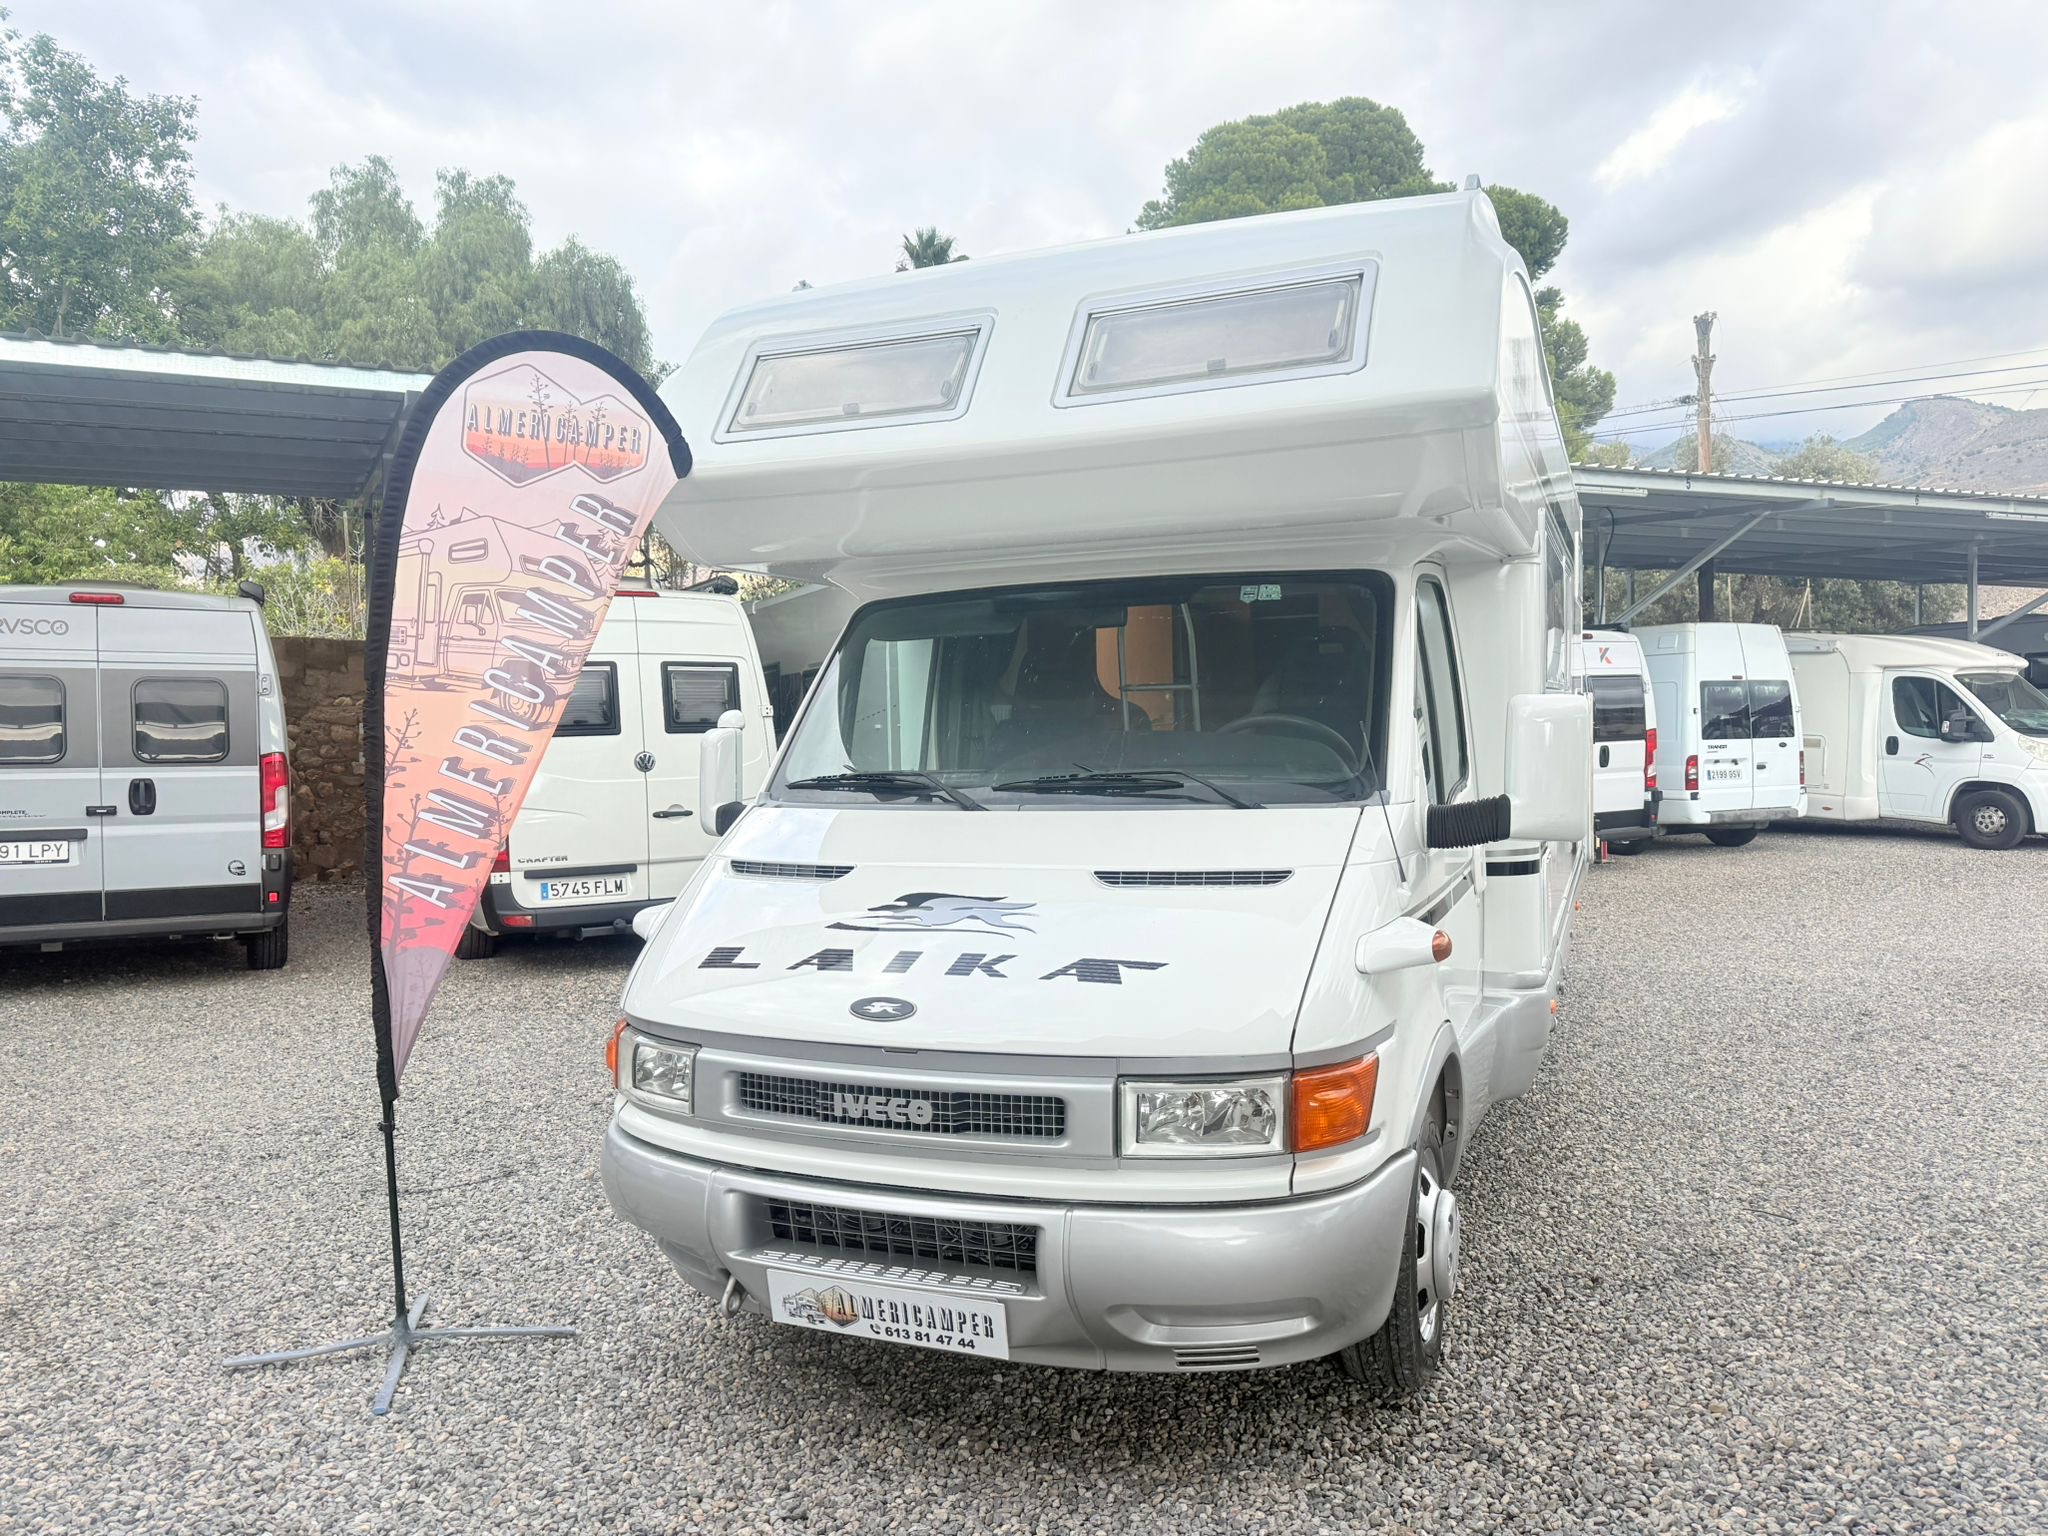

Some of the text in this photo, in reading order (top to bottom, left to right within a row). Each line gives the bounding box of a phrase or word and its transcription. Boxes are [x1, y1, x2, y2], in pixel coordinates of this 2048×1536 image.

[466, 404, 642, 454] ALMERICAMPER
[386, 493, 638, 909] ALMERICAMPER
[29, 843, 63, 858] LPY
[518, 855, 568, 864] CRAFTER
[550, 879, 623, 897] 5745 FLM
[698, 946, 1169, 985] LAIKA
[833, 1092, 933, 1125] IVECO
[836, 1292, 994, 1338] ALMERICAMPER
[885, 1326, 975, 1350] 613 81 47 44
